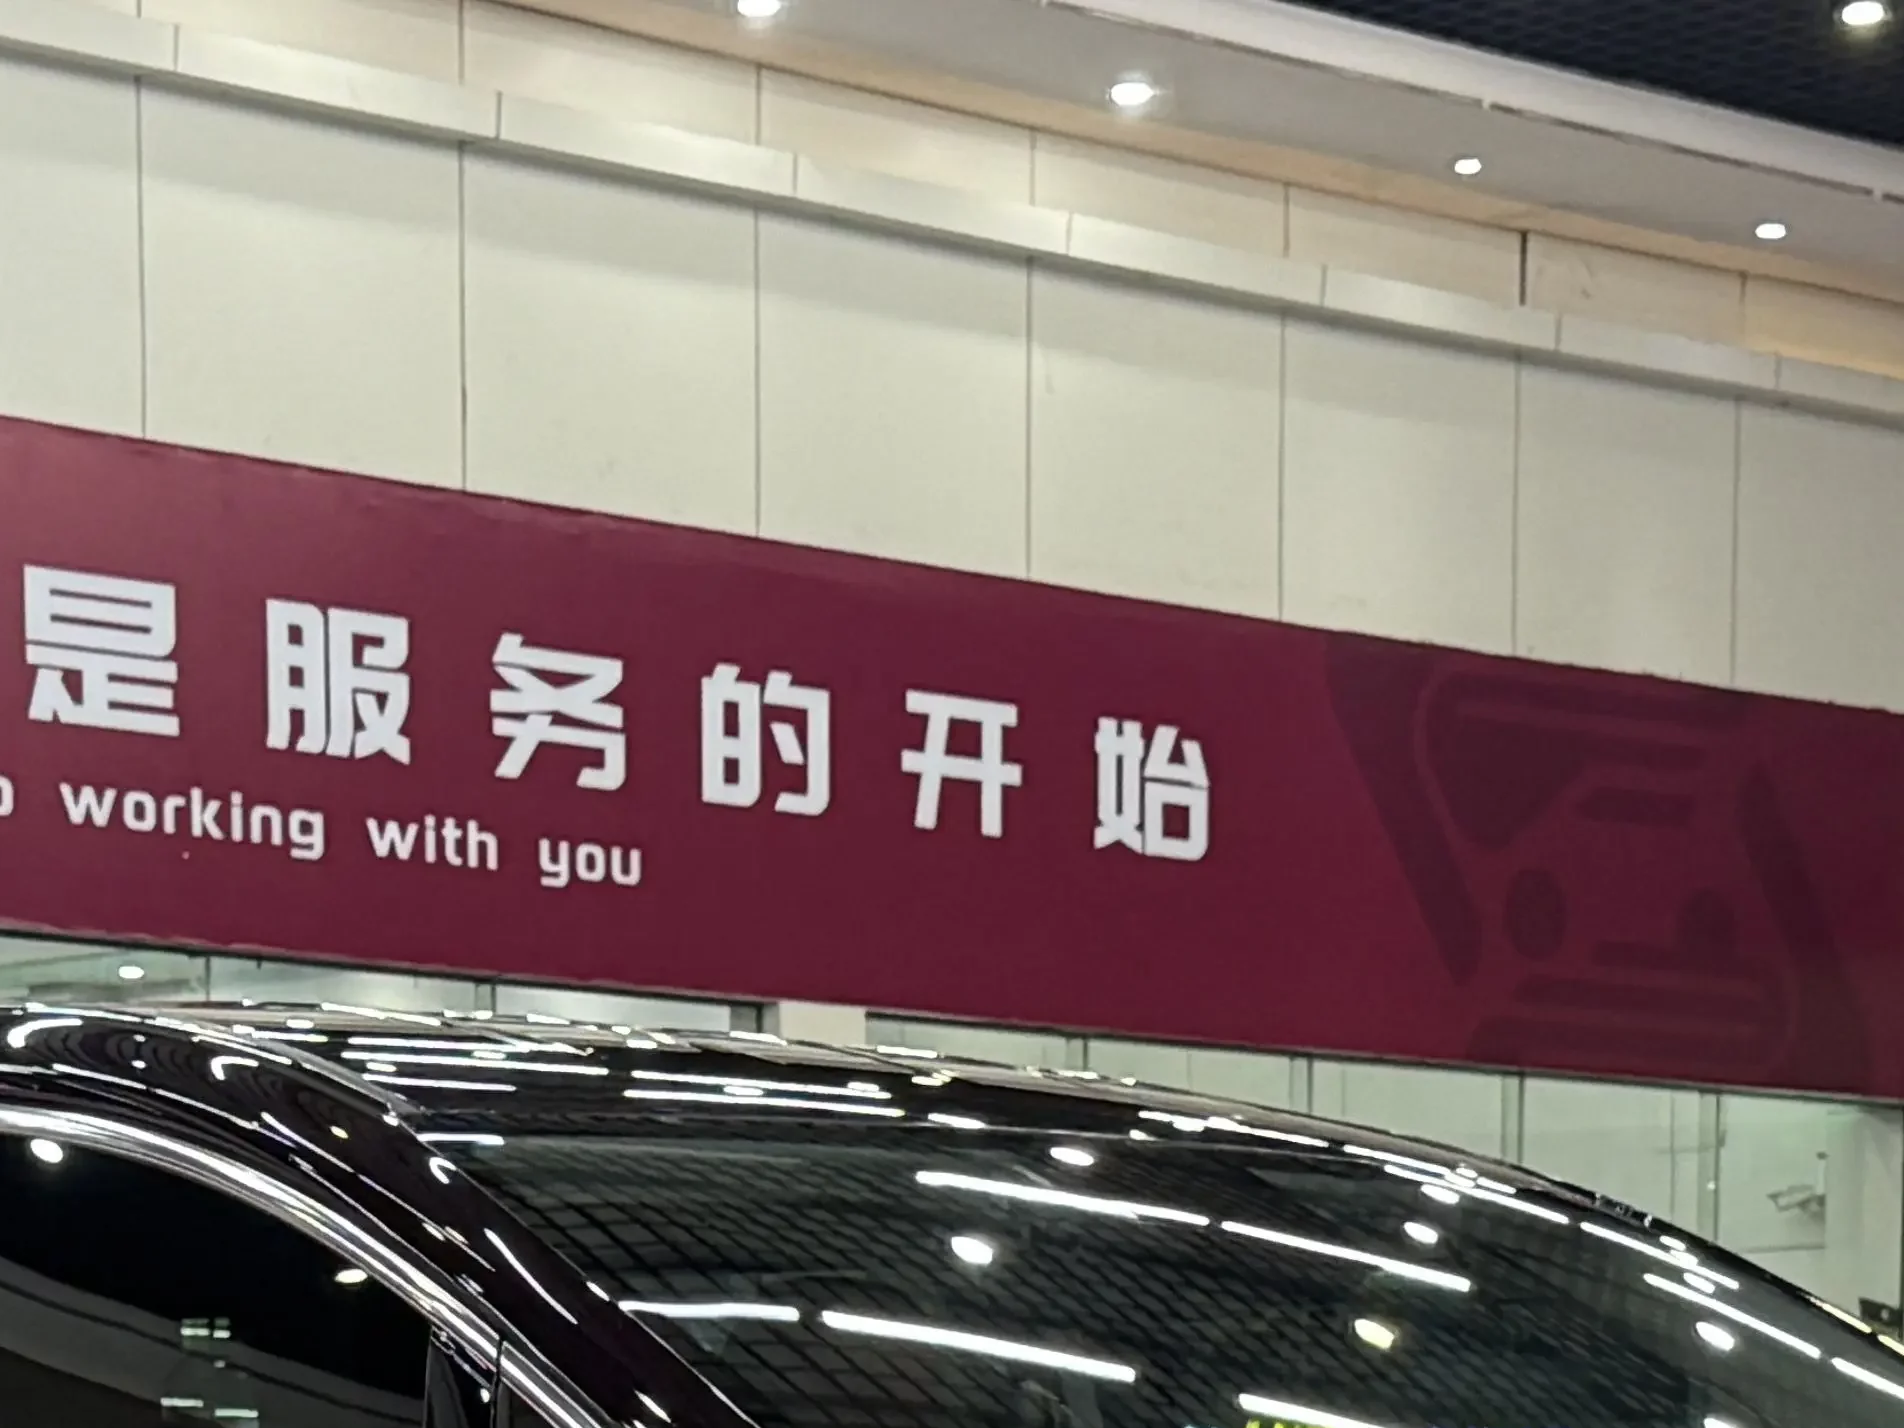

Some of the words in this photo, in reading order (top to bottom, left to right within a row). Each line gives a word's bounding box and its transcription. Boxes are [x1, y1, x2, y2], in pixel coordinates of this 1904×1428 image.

[61, 782, 324, 861] working
[367, 814, 498, 871] with
[539, 837, 642, 887] you
